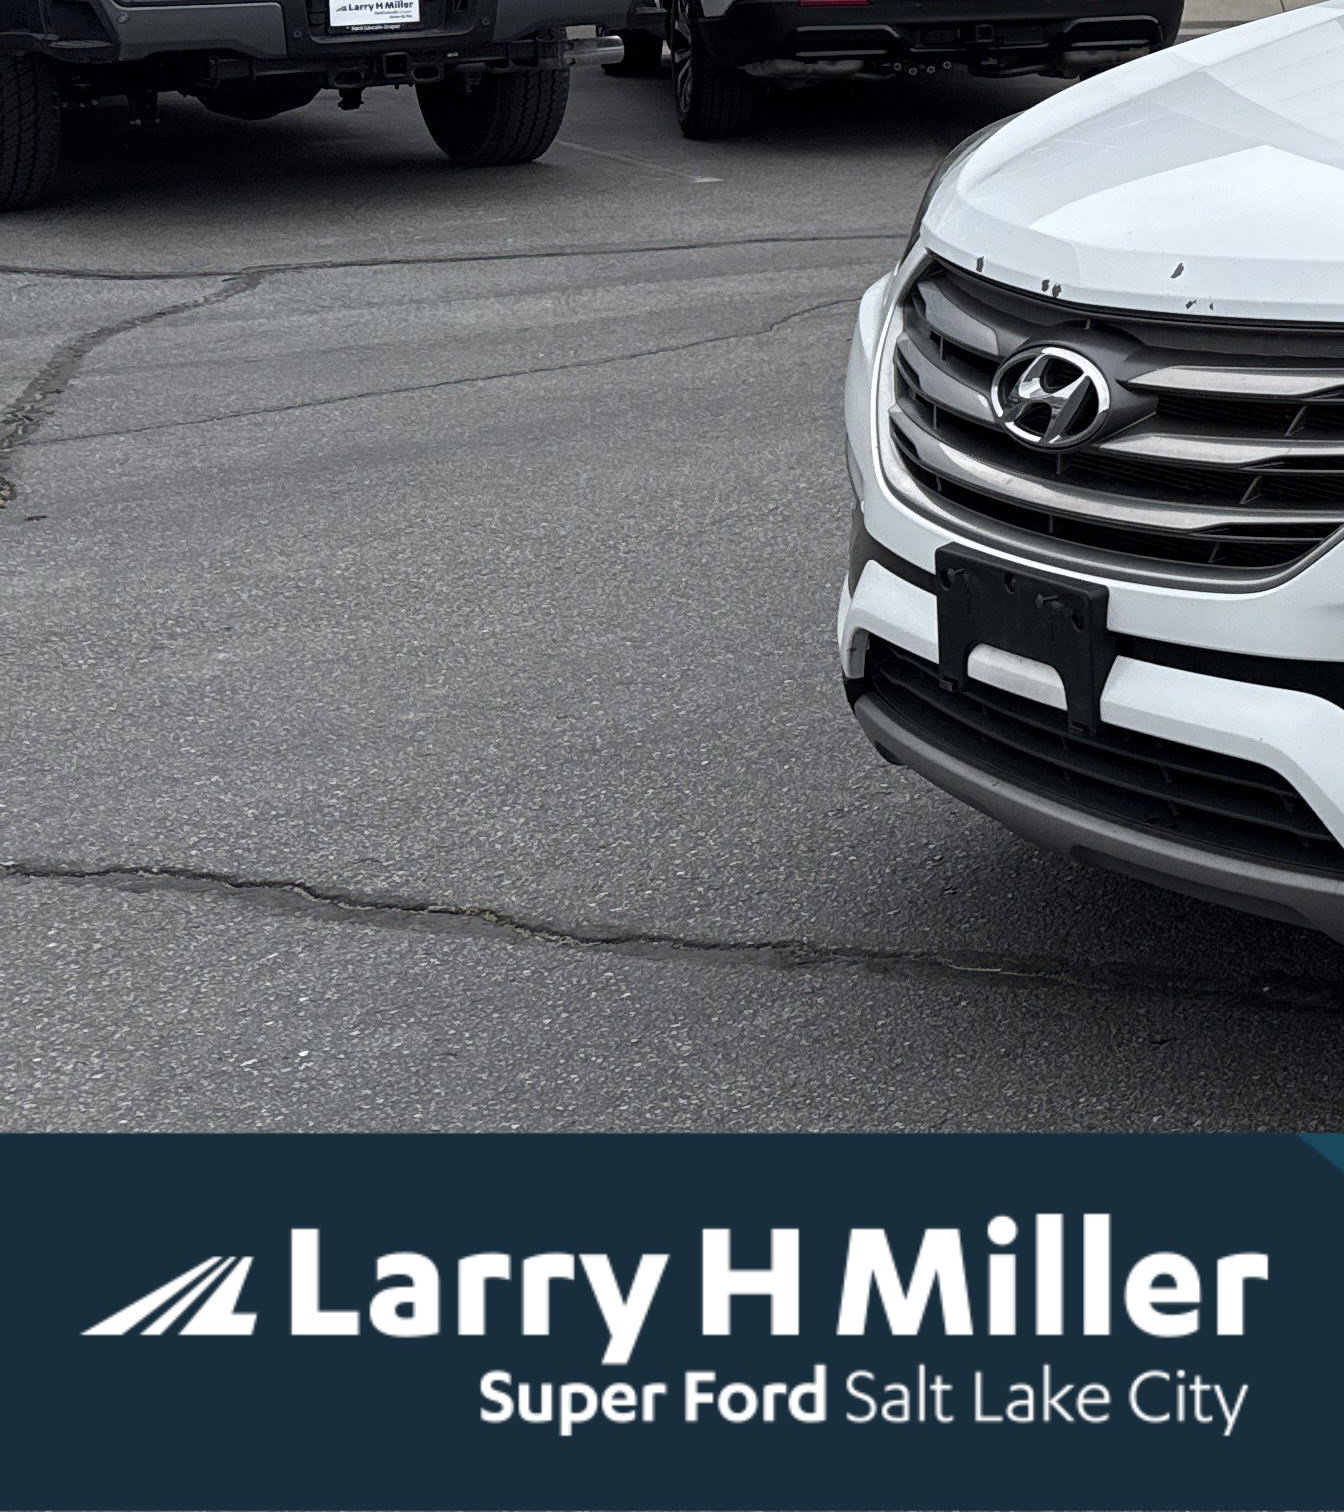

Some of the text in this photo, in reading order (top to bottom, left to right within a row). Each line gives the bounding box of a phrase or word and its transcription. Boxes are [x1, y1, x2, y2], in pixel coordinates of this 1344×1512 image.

[349, 0, 414, 12] Larry H Miller
